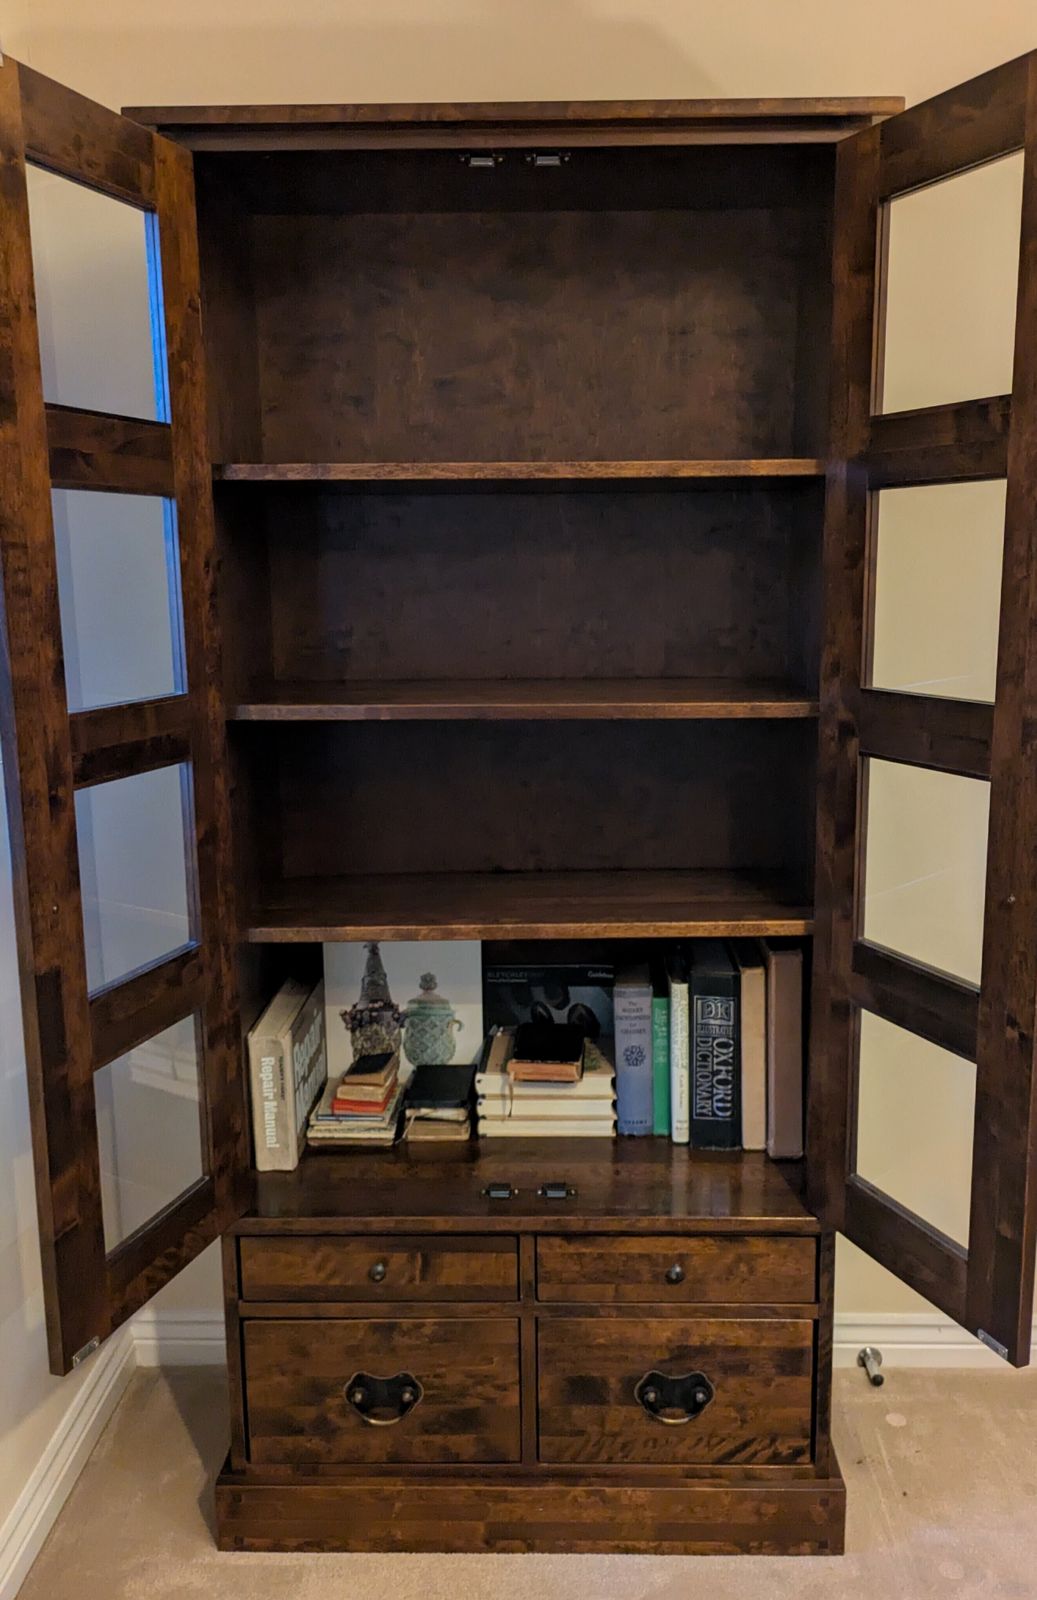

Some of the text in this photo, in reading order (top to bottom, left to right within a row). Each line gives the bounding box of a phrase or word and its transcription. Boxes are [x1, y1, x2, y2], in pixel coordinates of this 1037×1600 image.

[704, 1002, 730, 1018] DK
[260, 1056, 280, 1148] Repair Manual
[697, 1038, 712, 1116] DICTIONARY
[713, 1038, 734, 1117] OXFORD
